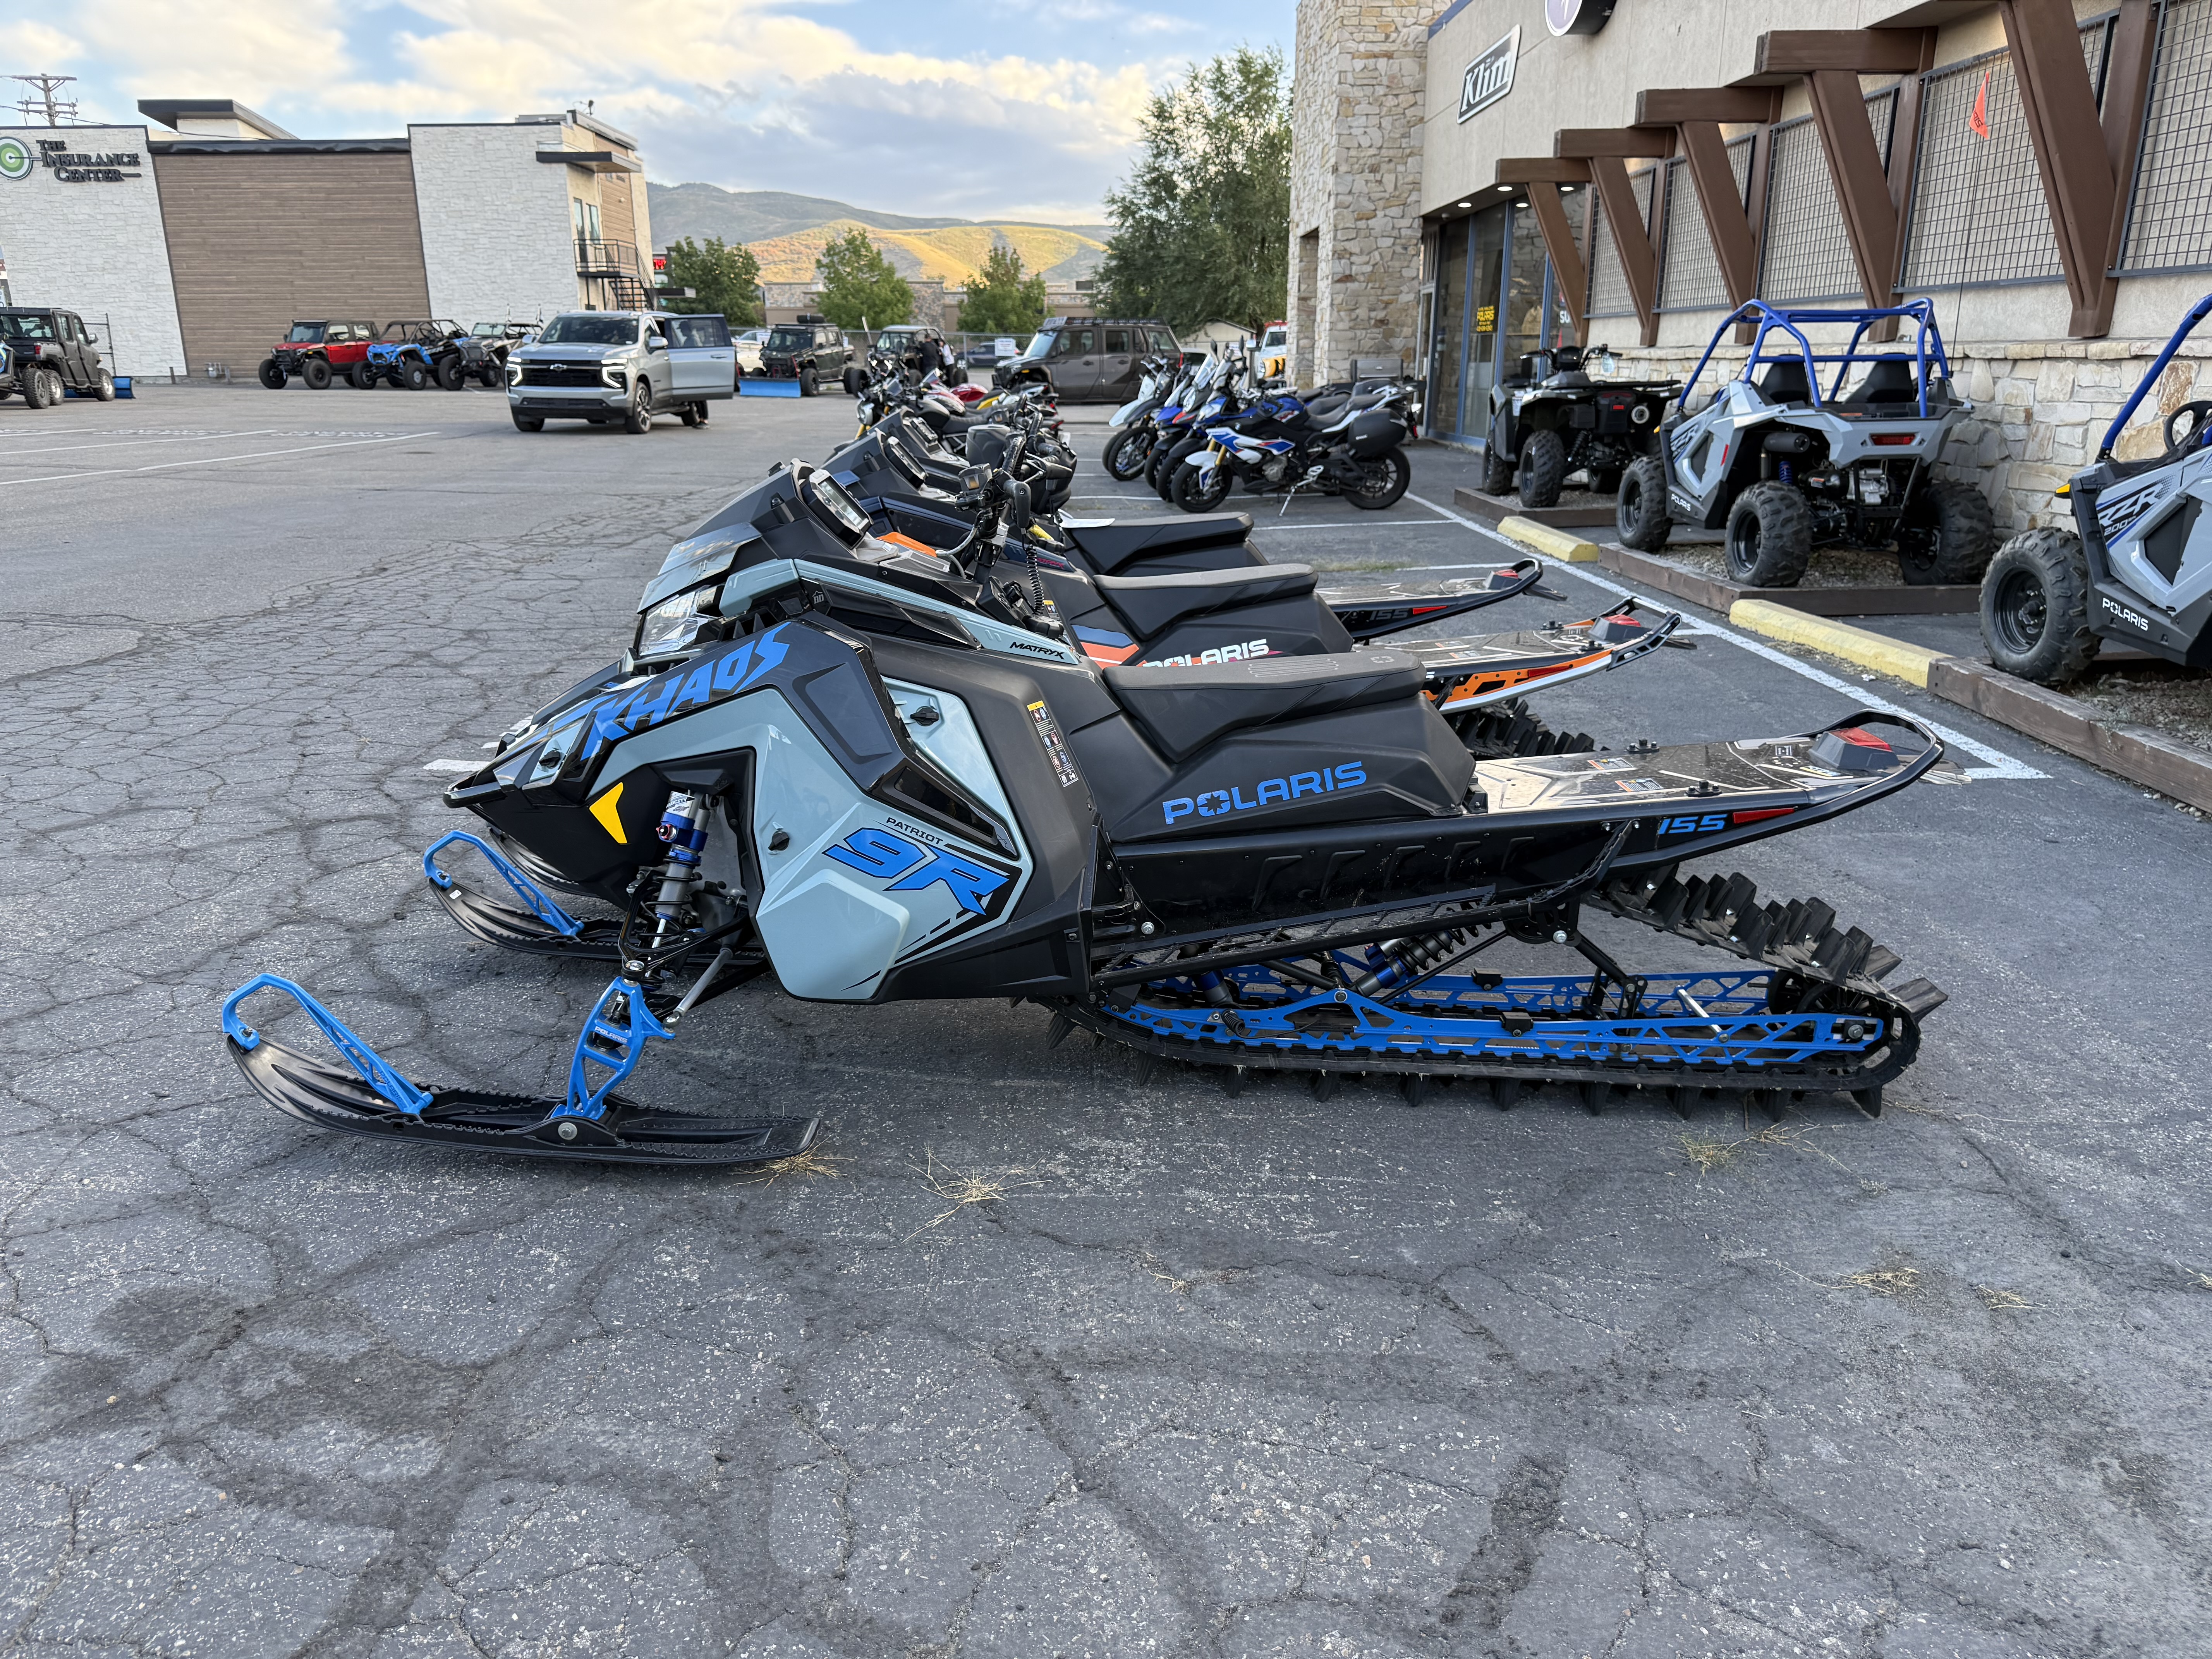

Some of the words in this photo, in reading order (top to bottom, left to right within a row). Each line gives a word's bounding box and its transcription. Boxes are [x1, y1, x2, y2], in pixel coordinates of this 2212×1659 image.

[1460, 51, 1512, 112] Klim
[36, 139, 67, 151] THE
[39, 151, 141, 167] INSURANCE
[53, 166, 125, 182] CENTER
[1671, 493, 1691, 512] POLARIS
[2097, 483, 2163, 527] RZR
[2104, 519, 2128, 536] 200
[1369, 609, 1409, 620] 155
[2102, 598, 2148, 631] POLARIS
[1009, 642, 1065, 660] MATRYX
[581, 621, 790, 761] KHAOS
[1162, 761, 1367, 824] POLARIS
[886, 817, 943, 845] PATRIOT
[1657, 814, 1728, 835] 155
[822, 827, 1009, 915] 9R
[594, 1026, 628, 1043] POLARIS
